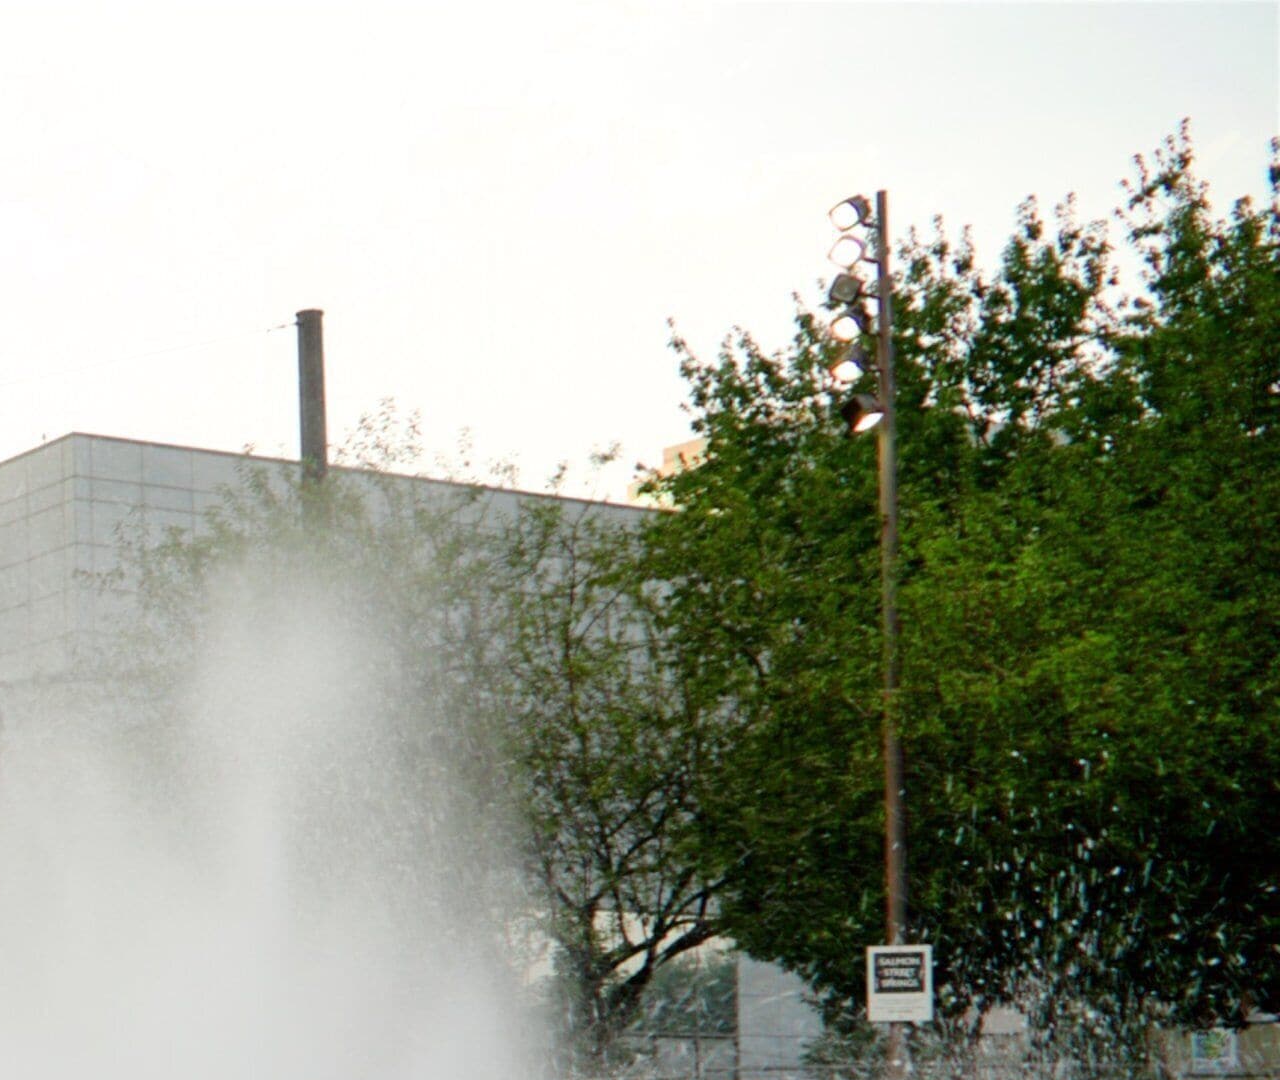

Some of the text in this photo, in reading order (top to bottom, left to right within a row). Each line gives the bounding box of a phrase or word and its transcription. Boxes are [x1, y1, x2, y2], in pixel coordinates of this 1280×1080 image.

[877, 957, 921, 967] SALMON
[882, 967, 917, 977] STREET
[880, 979, 919, 988] SPRINGS
